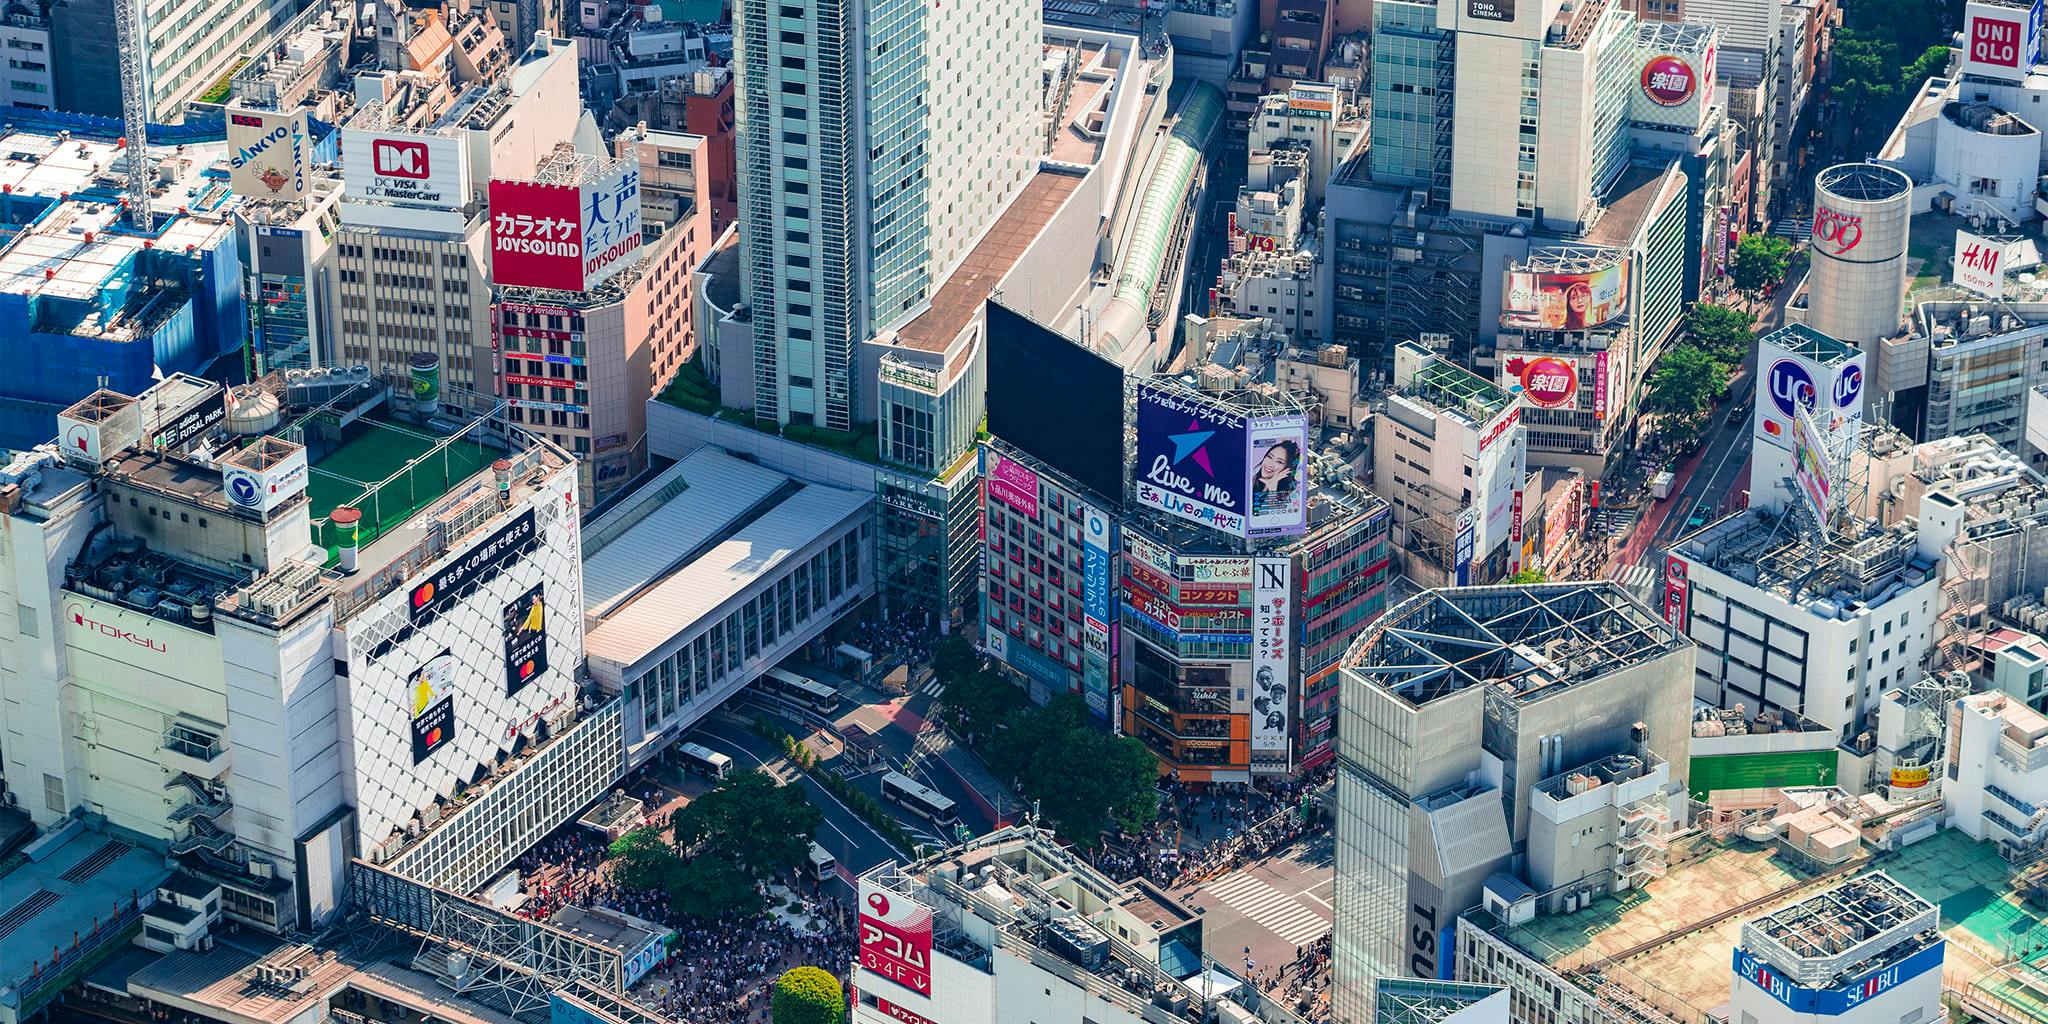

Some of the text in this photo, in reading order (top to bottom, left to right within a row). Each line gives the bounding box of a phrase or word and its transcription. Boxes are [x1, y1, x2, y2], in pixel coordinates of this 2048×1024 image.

[1472, 2, 1495, 11] TOHO
[1472, 9, 1502, 19] CINEMAS
[1977, 22, 2013, 43] UNI
[1975, 41, 2014, 62] QLO
[230, 126, 288, 170] SANKYO
[291, 119, 304, 193] SANKYO
[376, 143, 424, 175] DC
[365, 185, 441, 202] DC MasterCard
[374, 177, 388, 187] DC
[392, 180, 417, 190] VISA
[582, 170, 639, 235] 大声
[495, 211, 577, 241] カラオケ
[1812, 212, 1863, 255] 109
[495, 236, 580, 258] JOYSOUND
[584, 231, 641, 278] JOYSOUND
[1961, 242, 2000, 275] H&M
[1962, 273, 1986, 288] 150m
[1529, 374, 1569, 392] 楽園
[179, 412, 200, 430] adidas
[179, 421, 206, 441] FUTSAL
[1147, 454, 1195, 494] live
[1204, 483, 1235, 507] me
[881, 494, 914, 510] MARK
[438, 520, 531, 592] 最も多くの場所で使える
[1180, 590, 1237, 600] コンタクト
[1145, 600, 1167, 620] ガスト
[1219, 610, 1245, 619] ガスト
[84, 618, 166, 653] TOKYU
[863, 922, 925, 968] アコム
[1741, 957, 1792, 1005] SEIBU
[1845, 966, 1899, 1009] SEIBU
